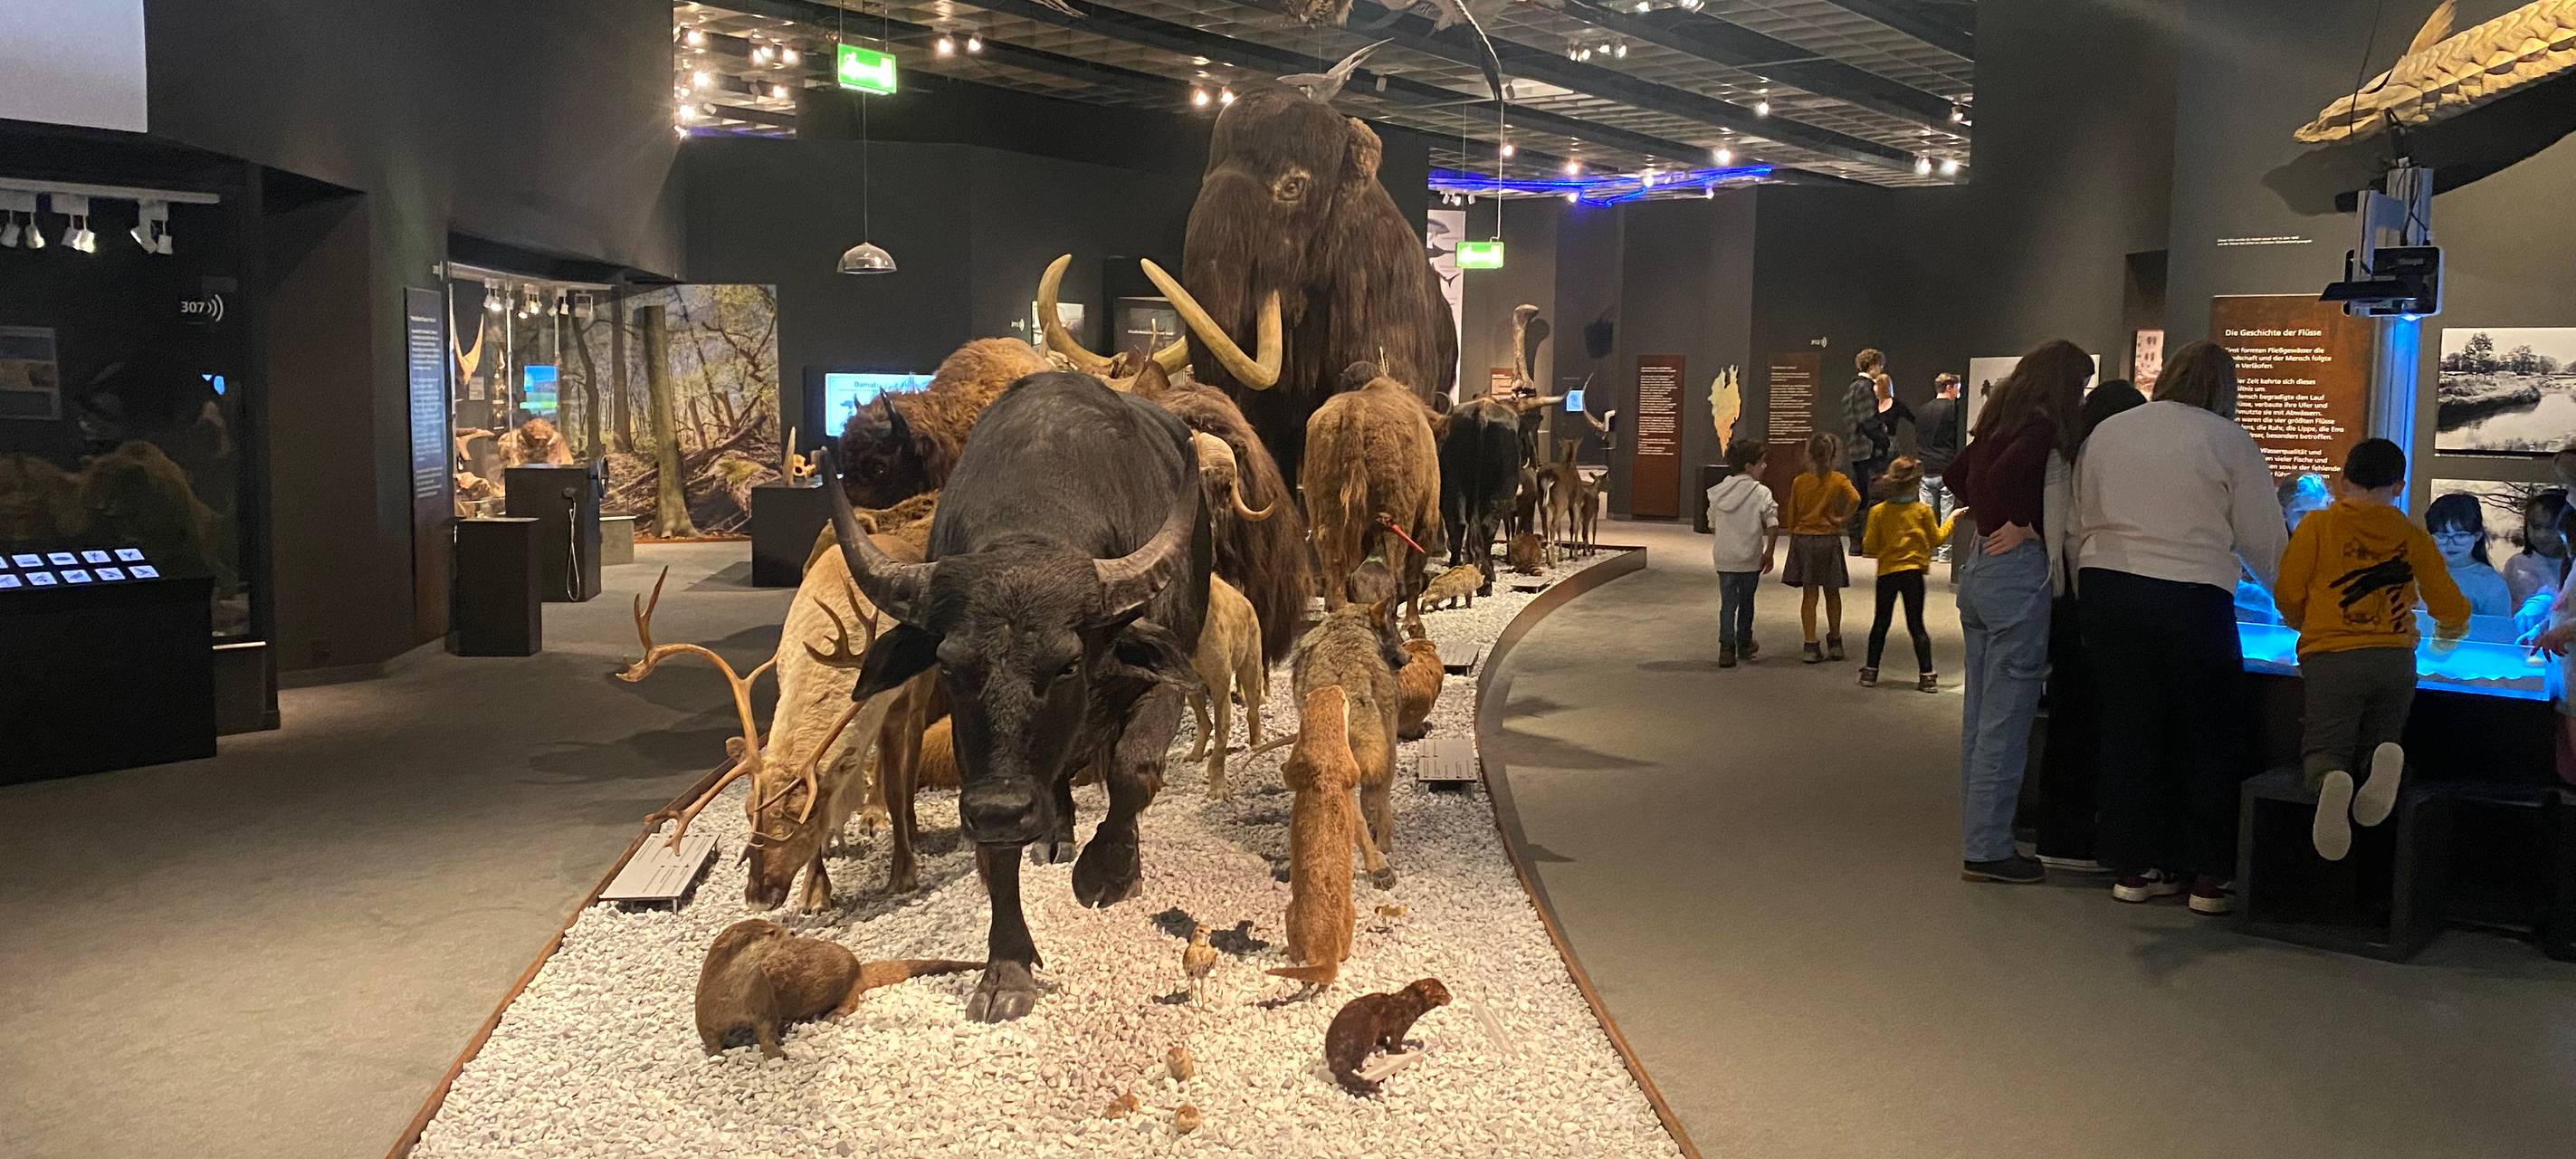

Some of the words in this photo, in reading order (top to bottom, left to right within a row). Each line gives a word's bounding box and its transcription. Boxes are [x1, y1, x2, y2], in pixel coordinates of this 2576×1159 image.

[181, 301, 205, 312] 307
[2225, 329, 2237, 337] Die
[2240, 329, 2281, 337] Geschichte
[2283, 329, 2297, 337] der
[2298, 329, 2322, 337] Flüsse
[2312, 355, 2332, 363] folgte
[2259, 393, 2295, 401] begradigte
[2260, 447, 2308, 455] Wasserqualität
